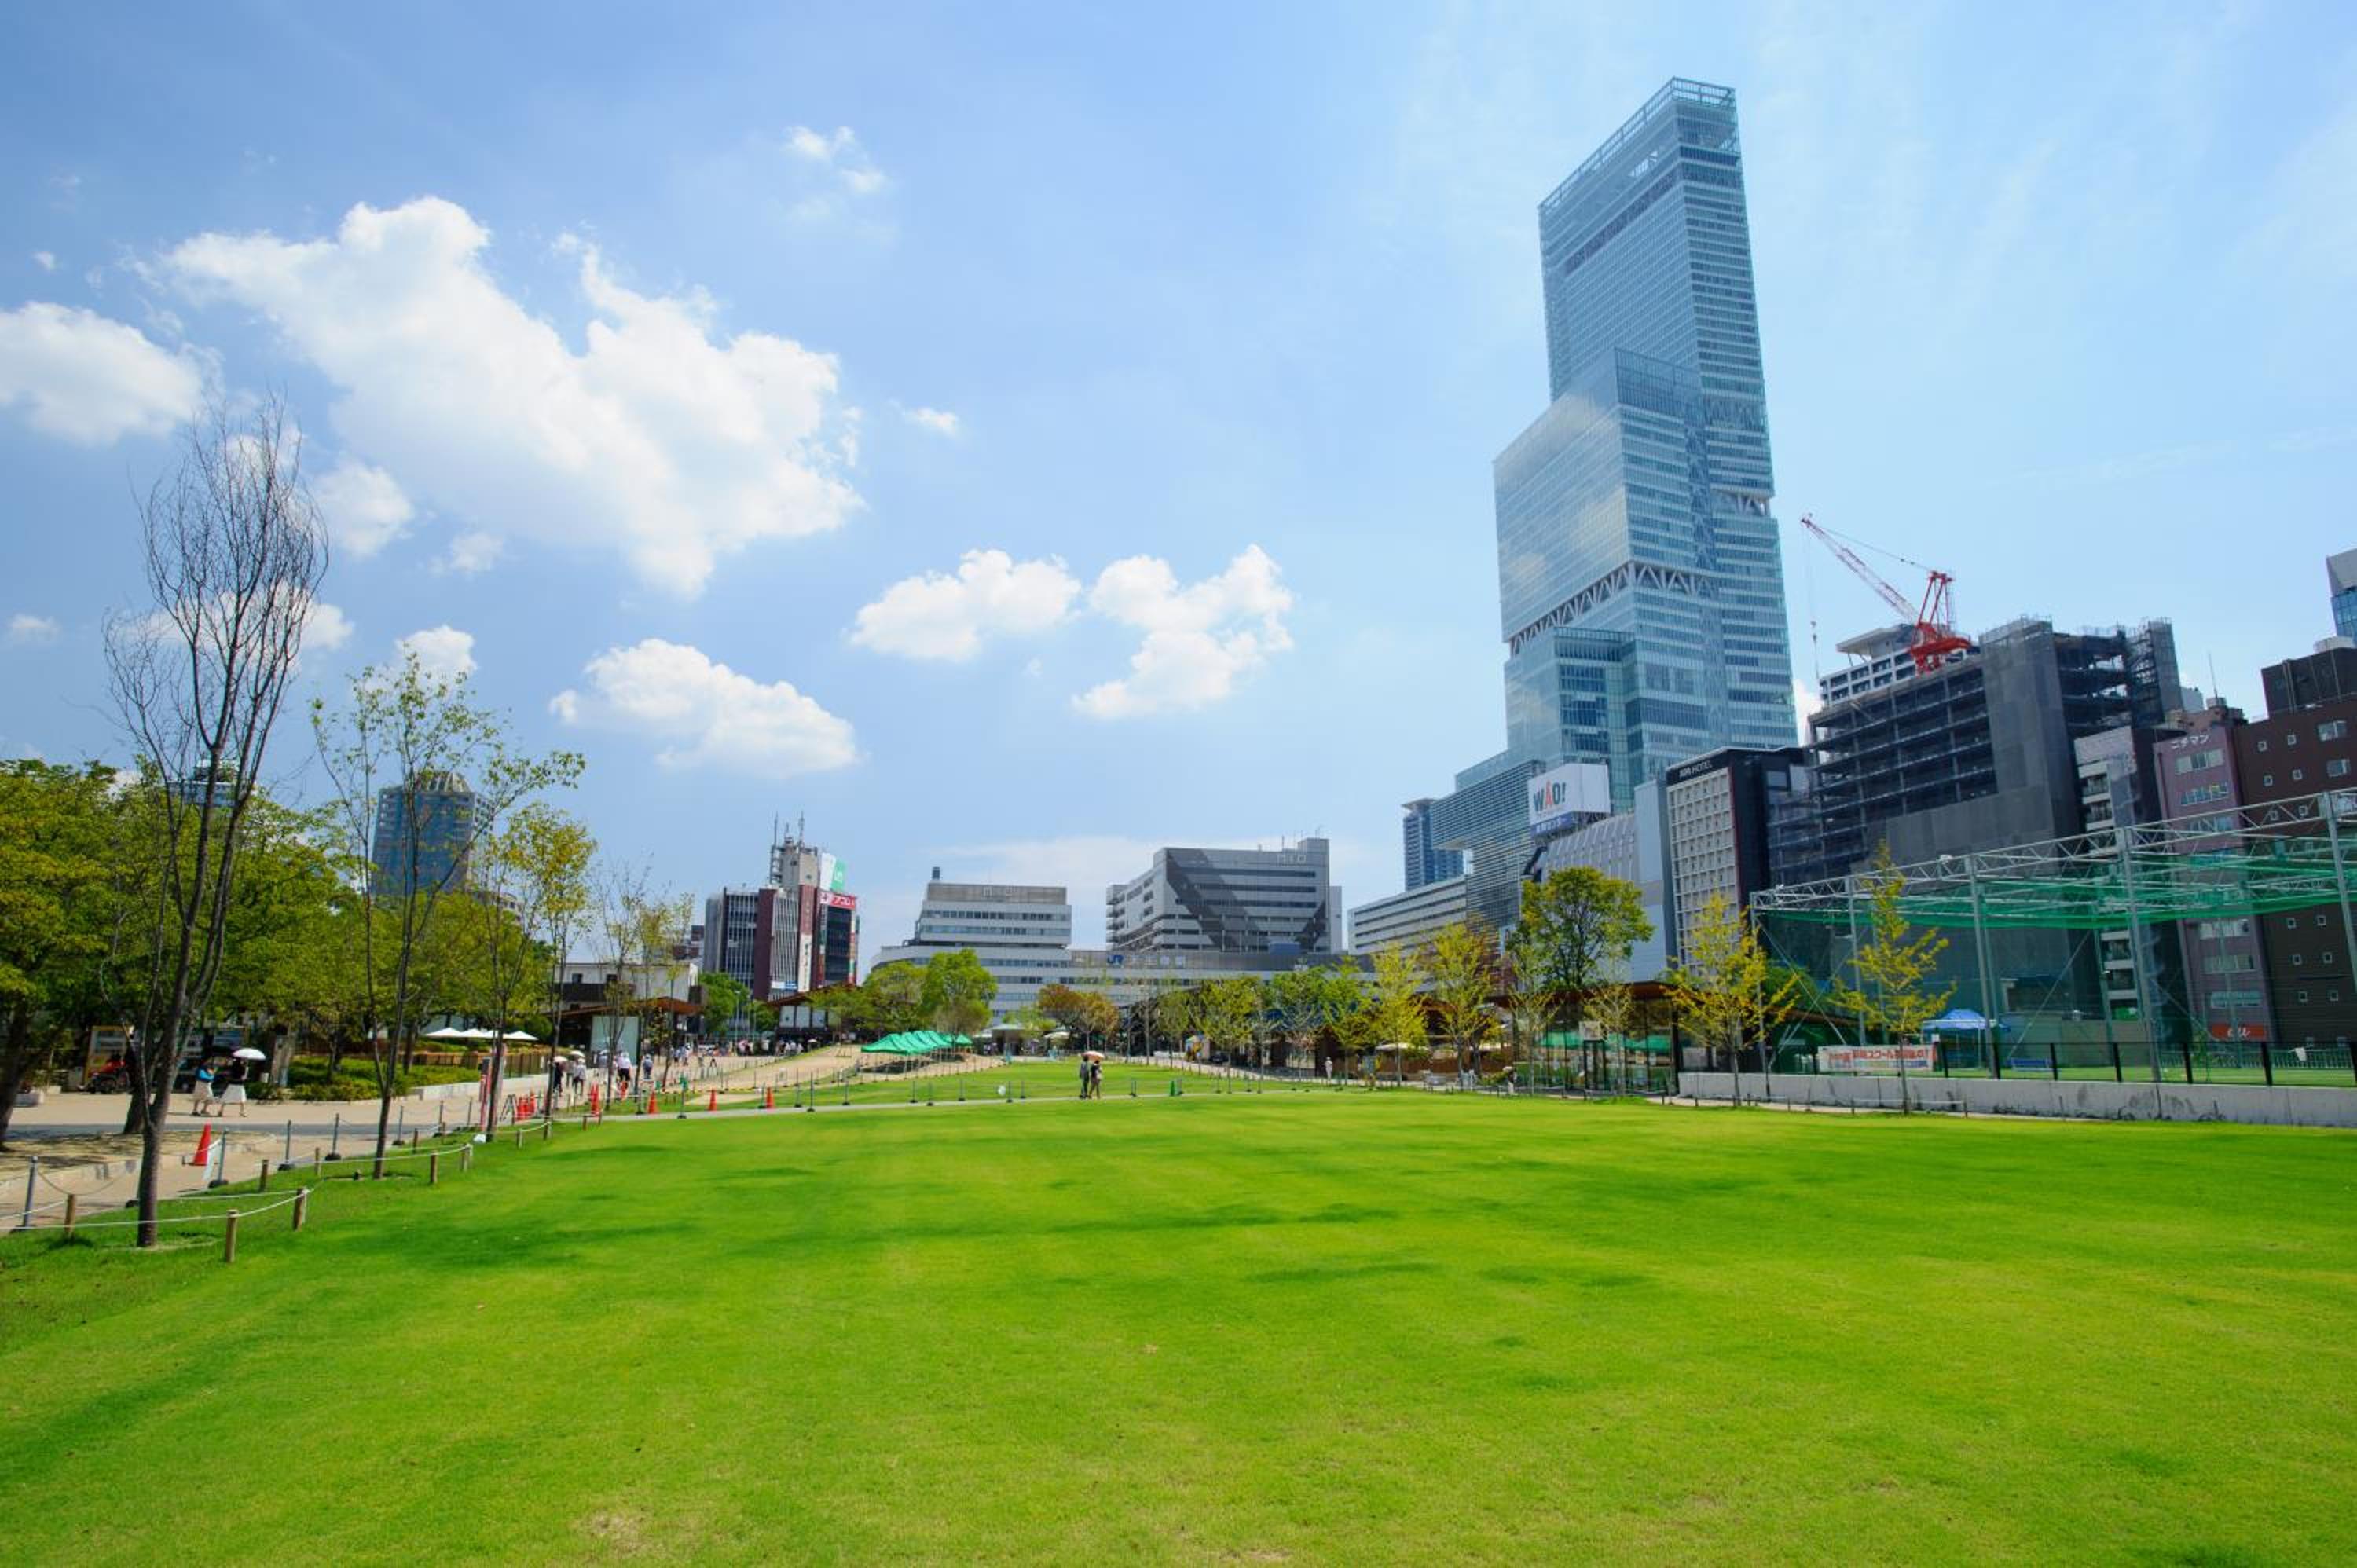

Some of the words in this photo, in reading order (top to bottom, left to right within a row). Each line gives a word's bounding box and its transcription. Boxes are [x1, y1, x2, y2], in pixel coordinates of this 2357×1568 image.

[2170, 735, 2209, 749] ニチマン
[1692, 761, 1713, 775] HOTEL
